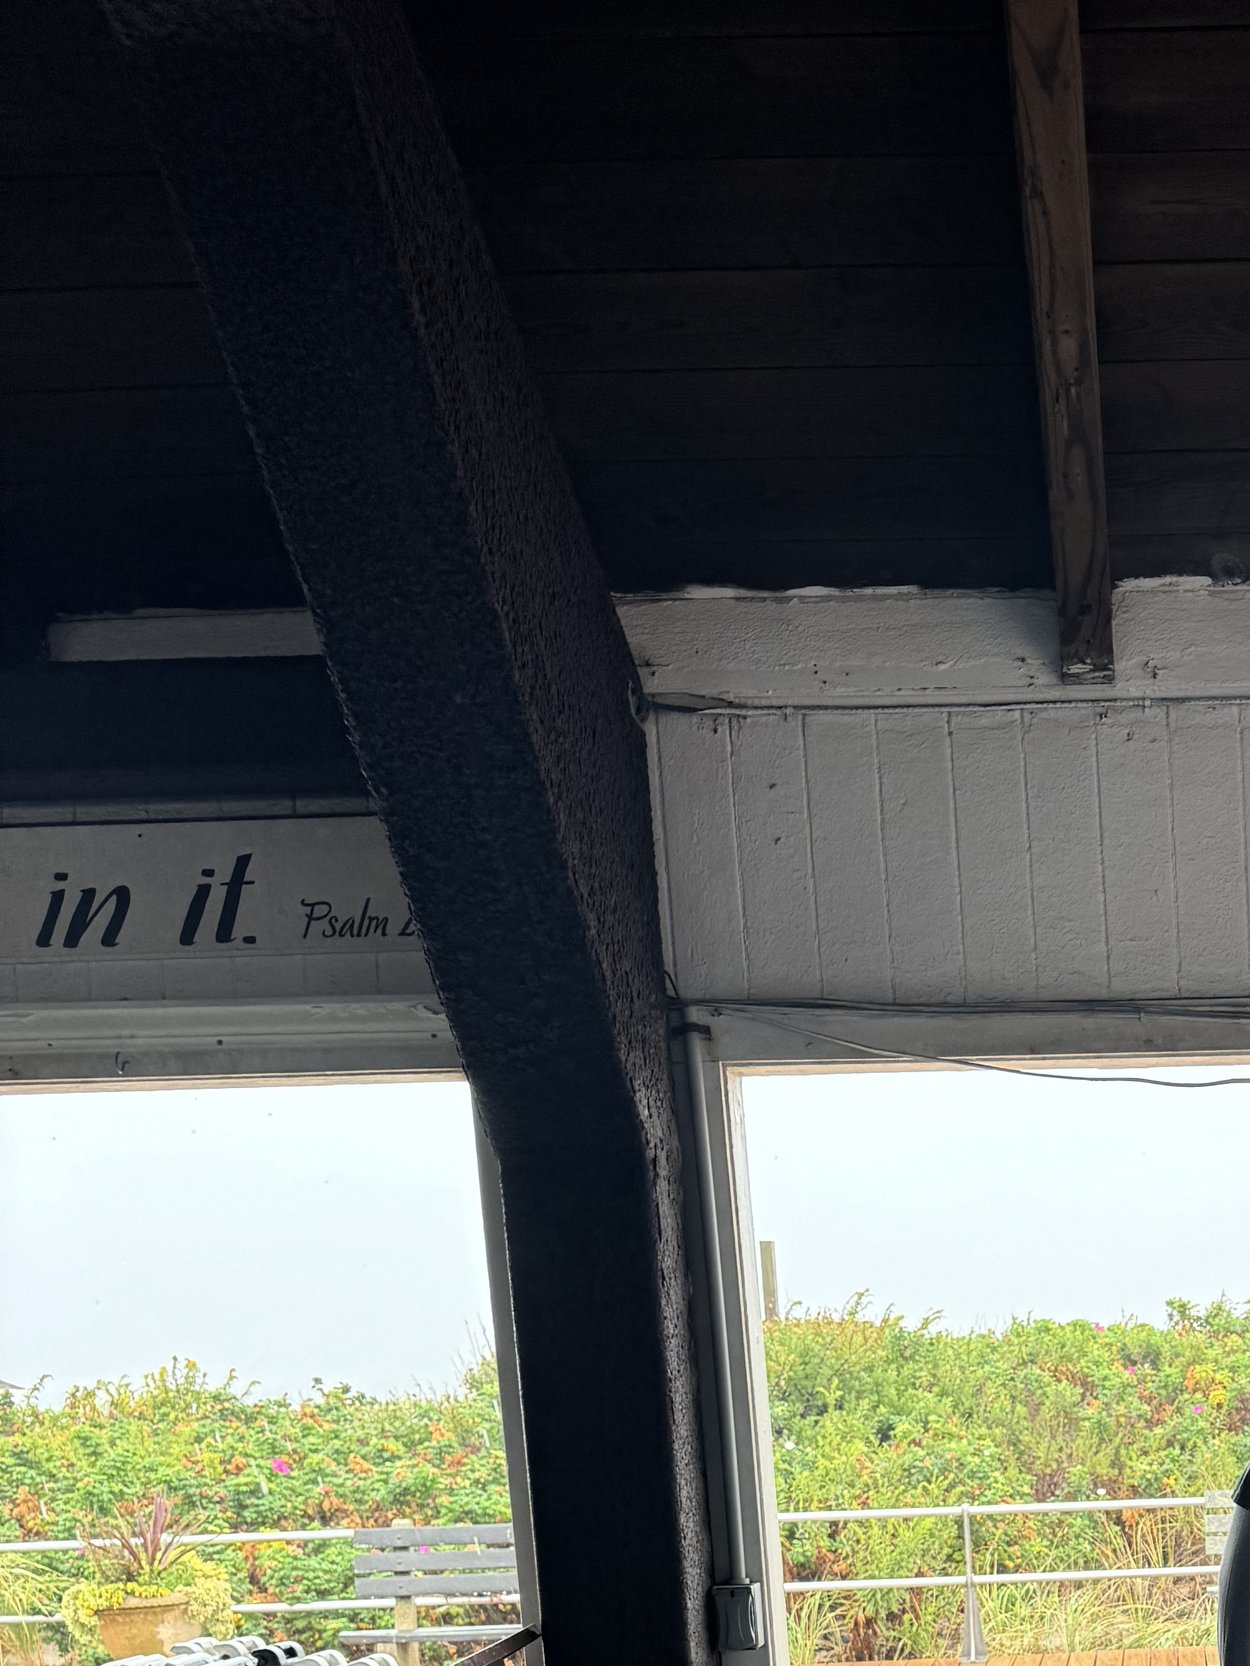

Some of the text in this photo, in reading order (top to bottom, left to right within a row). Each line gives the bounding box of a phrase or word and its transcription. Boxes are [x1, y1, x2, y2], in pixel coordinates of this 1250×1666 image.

[35, 872, 131, 949] in
[179, 853, 257, 946] it.
[301, 897, 389, 940] Psalm
